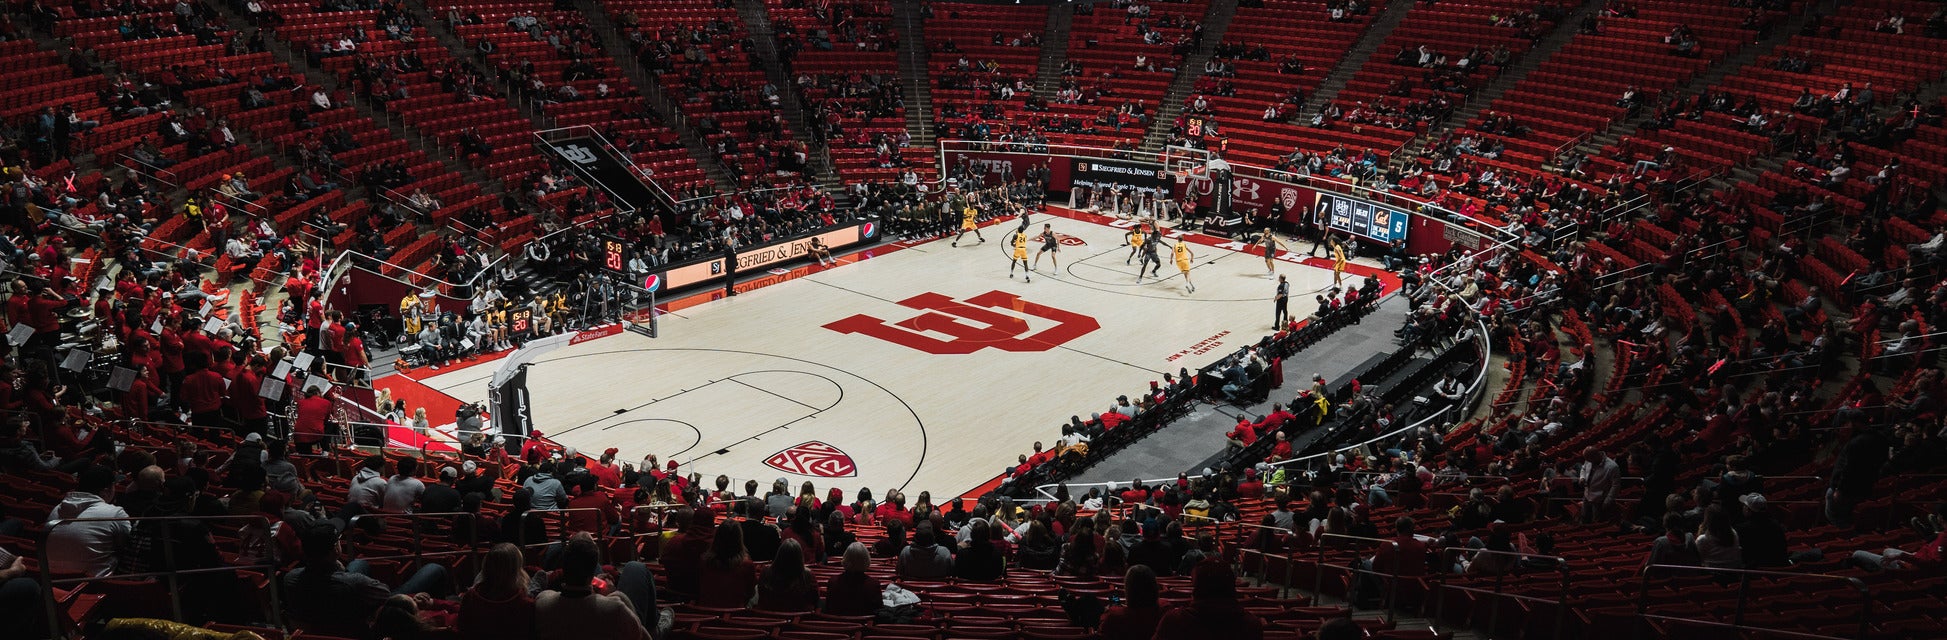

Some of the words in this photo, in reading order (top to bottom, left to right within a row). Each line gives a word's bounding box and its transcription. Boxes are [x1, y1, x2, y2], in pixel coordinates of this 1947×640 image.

[1188, 125, 1200, 136] 20
[1099, 164, 1127, 173] SIEGFRIED
[1127, 167, 1133, 175] &
[1133, 168, 1155, 176] JENSEN
[1321, 202, 1328, 213] 7
[1375, 210, 1389, 224] Cal
[1395, 221, 1402, 233] 5
[777, 245, 788, 259] &
[607, 251, 622, 270] 20
[512, 311, 530, 320] 15:13
[513, 320, 526, 331] 20
[1193, 341, 1224, 355] CENTER
[1166, 354, 1182, 362] JON
[766, 441, 841, 474] PAC
[814, 460, 851, 475] 12
